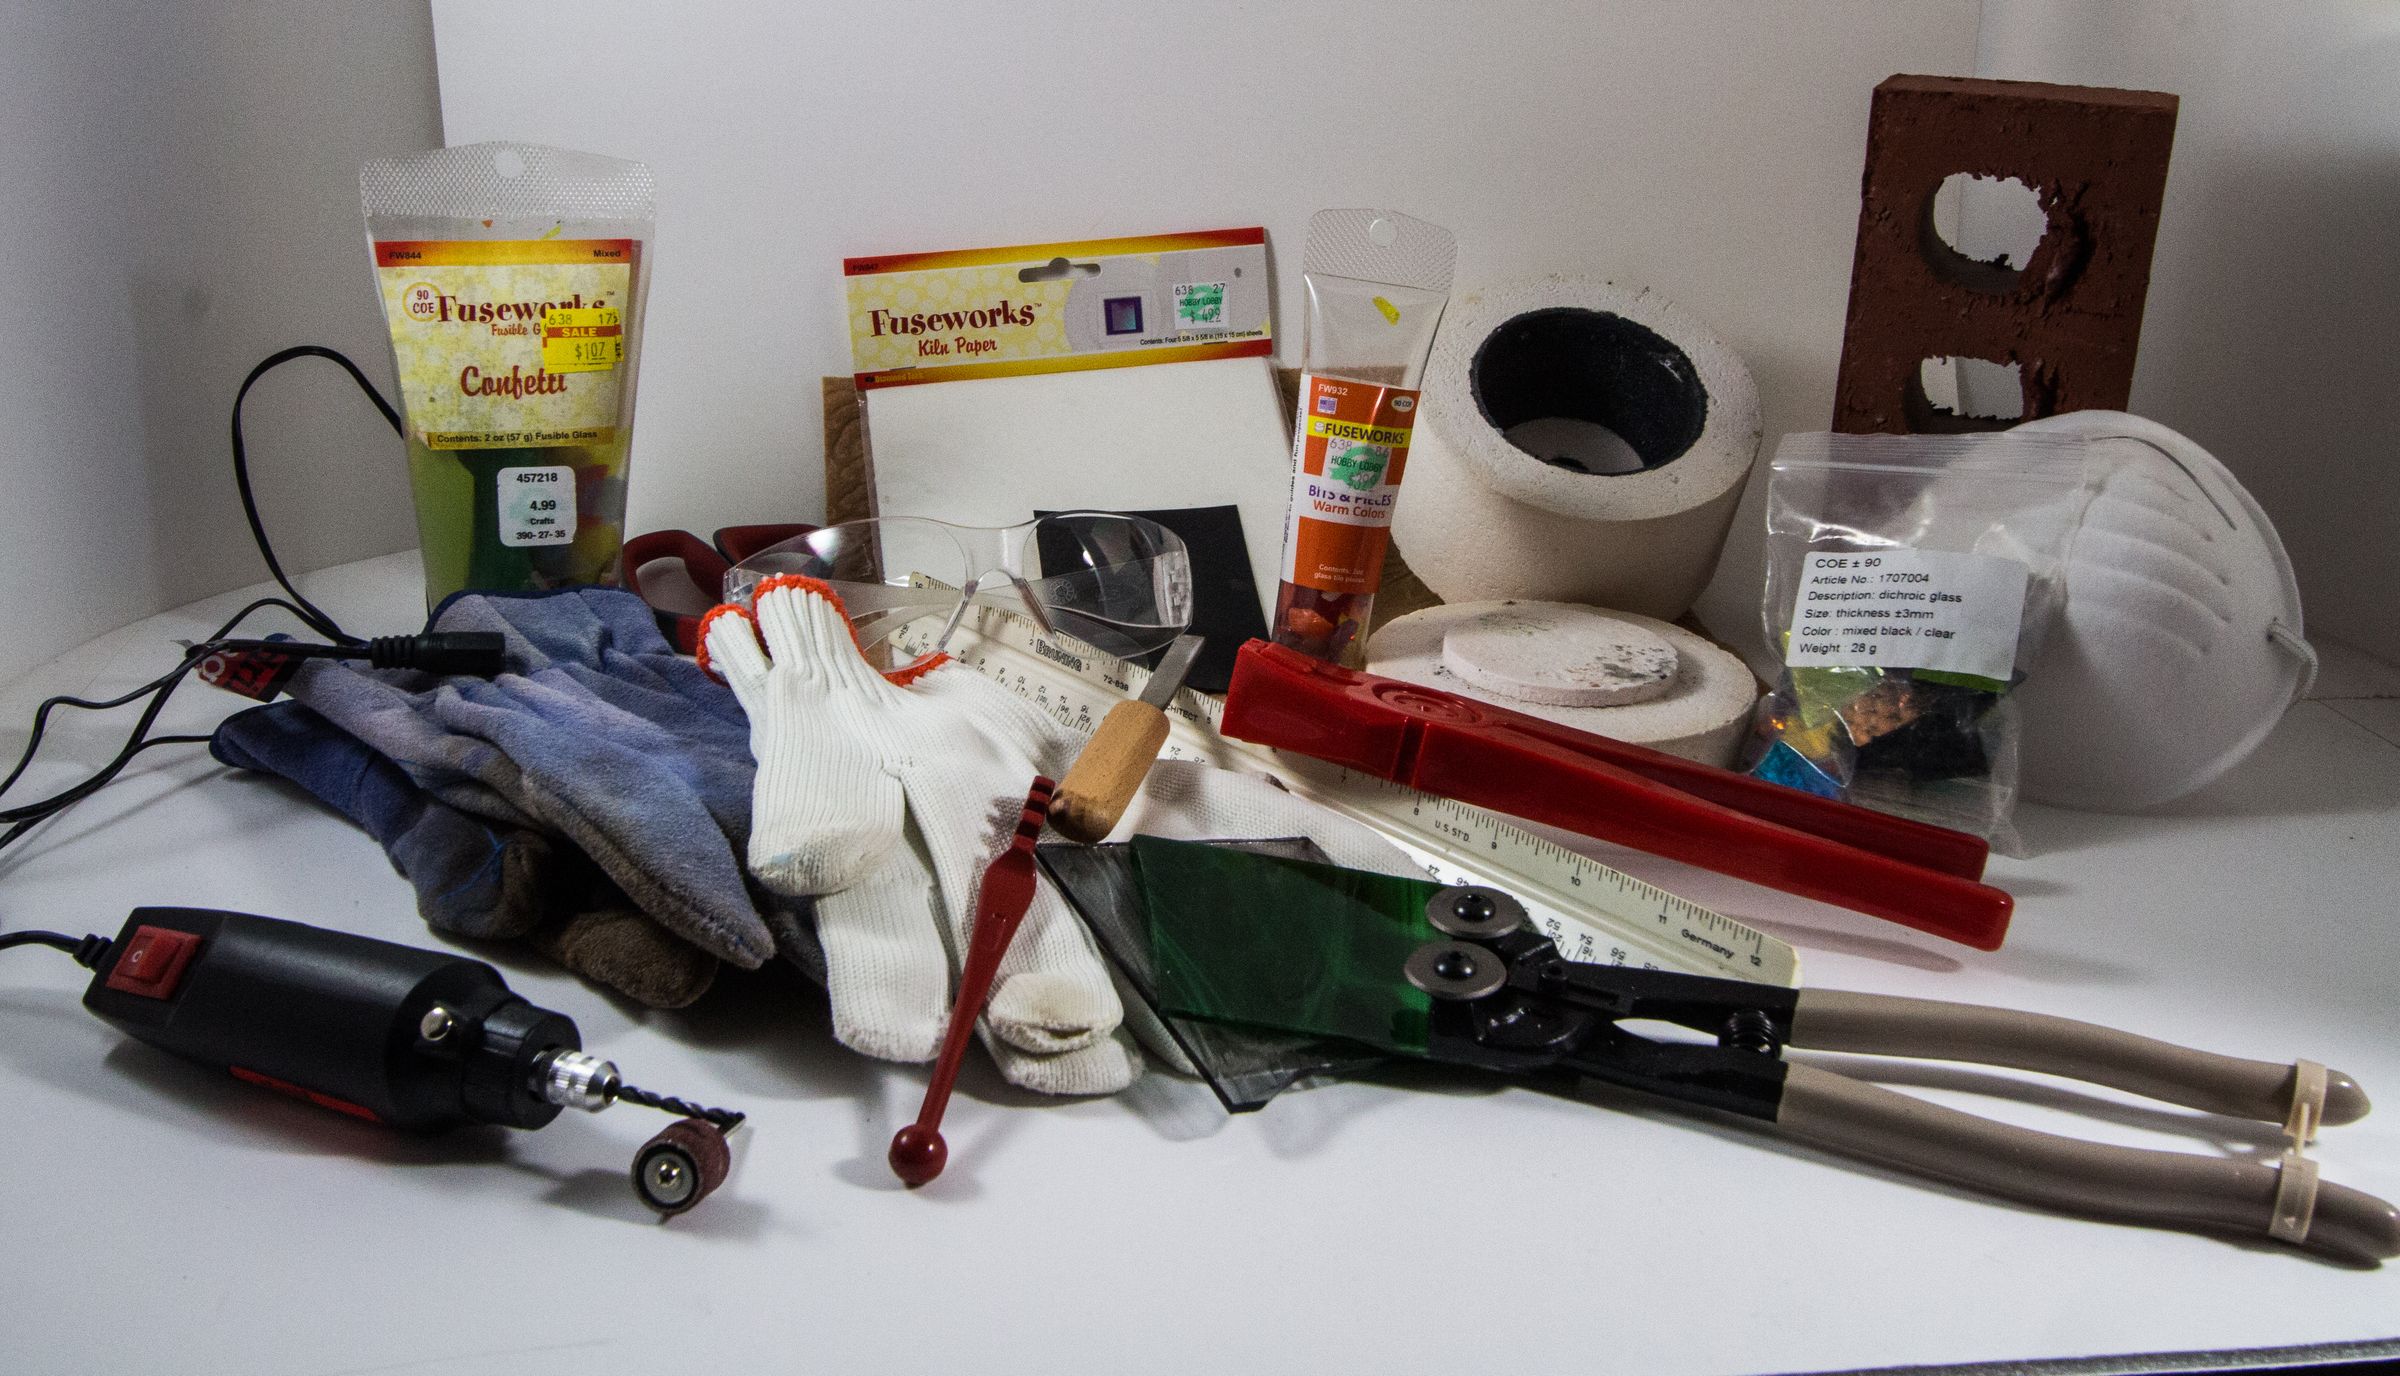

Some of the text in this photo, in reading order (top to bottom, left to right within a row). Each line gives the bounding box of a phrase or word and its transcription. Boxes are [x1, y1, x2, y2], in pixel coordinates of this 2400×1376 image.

[389, 252, 422, 260] FW844
[593, 249, 621, 258] Mixed
[416, 290, 429, 300] 90
[1175, 283, 1226, 295] 638 27
[1179, 296, 1223, 307] HOBBY LOBBY
[413, 303, 434, 314] COE
[549, 314, 572, 325] 638
[867, 300, 1036, 338] Fuseworks
[491, 323, 528, 336] Fusible
[562, 327, 598, 338] SALE
[918, 336, 998, 357] Kiln Paper
[461, 365, 568, 400] Confetti
[1318, 383, 1348, 396] FW932
[437, 434, 482, 443] Contents:
[485, 434, 490, 442] 2
[506, 433, 520, 443] (57
[524, 433, 533, 443] g)
[535, 432, 569, 440] Fusible
[572, 431, 598, 439] Glass
[1324, 422, 1404, 445] FUSEWORKS
[1330, 438, 1353, 451] 638
[1331, 455, 1384, 472] HOBBY LOBBY
[516, 473, 558, 483] 457218
[530, 500, 557, 511] 4.99
[1313, 499, 1385, 519] Warm Colors
[530, 517, 555, 525] Crafts
[1815, 558, 1847, 569] COE
[1864, 558, 1882, 568] 90
[1811, 575, 1847, 585] Article
[1879, 573, 1930, 584] 1707004
[1808, 590, 1963, 603] Description: dichroic glass
[1804, 608, 1934, 619] Size: thickness ±3mm
[1802, 627, 1832, 637] Color
[1842, 626, 1877, 636] mixed
[1881, 625, 1912, 637] black
[1924, 627, 1956, 640] clear
[1800, 642, 1840, 655] Weight
[1850, 642, 1866, 653] 28
[1869, 645, 1877, 655] g
[1029, 638, 1034, 646] 2
[1341, 775, 1346, 783] 7
[1413, 807, 1419, 816] 8
[1491, 841, 1497, 850] 9
[1571, 876, 1581, 886] 10
[1658, 914, 1668, 924] 11
[1750, 955, 1762, 967] 12
[1018, 676, 1026, 685] 10
[1038, 686, 1047, 694] 12
[1060, 696, 1068, 704] 14
[1081, 705, 1089, 714] 16
[1427, 864, 1441, 875] 44
[1546, 917, 1562, 932] 52
[1579, 933, 1594, 946] 54
[1610, 947, 1626, 959] 56
[1681, 928, 1735, 959] Germany
[1581, 946, 1593, 957] 16
